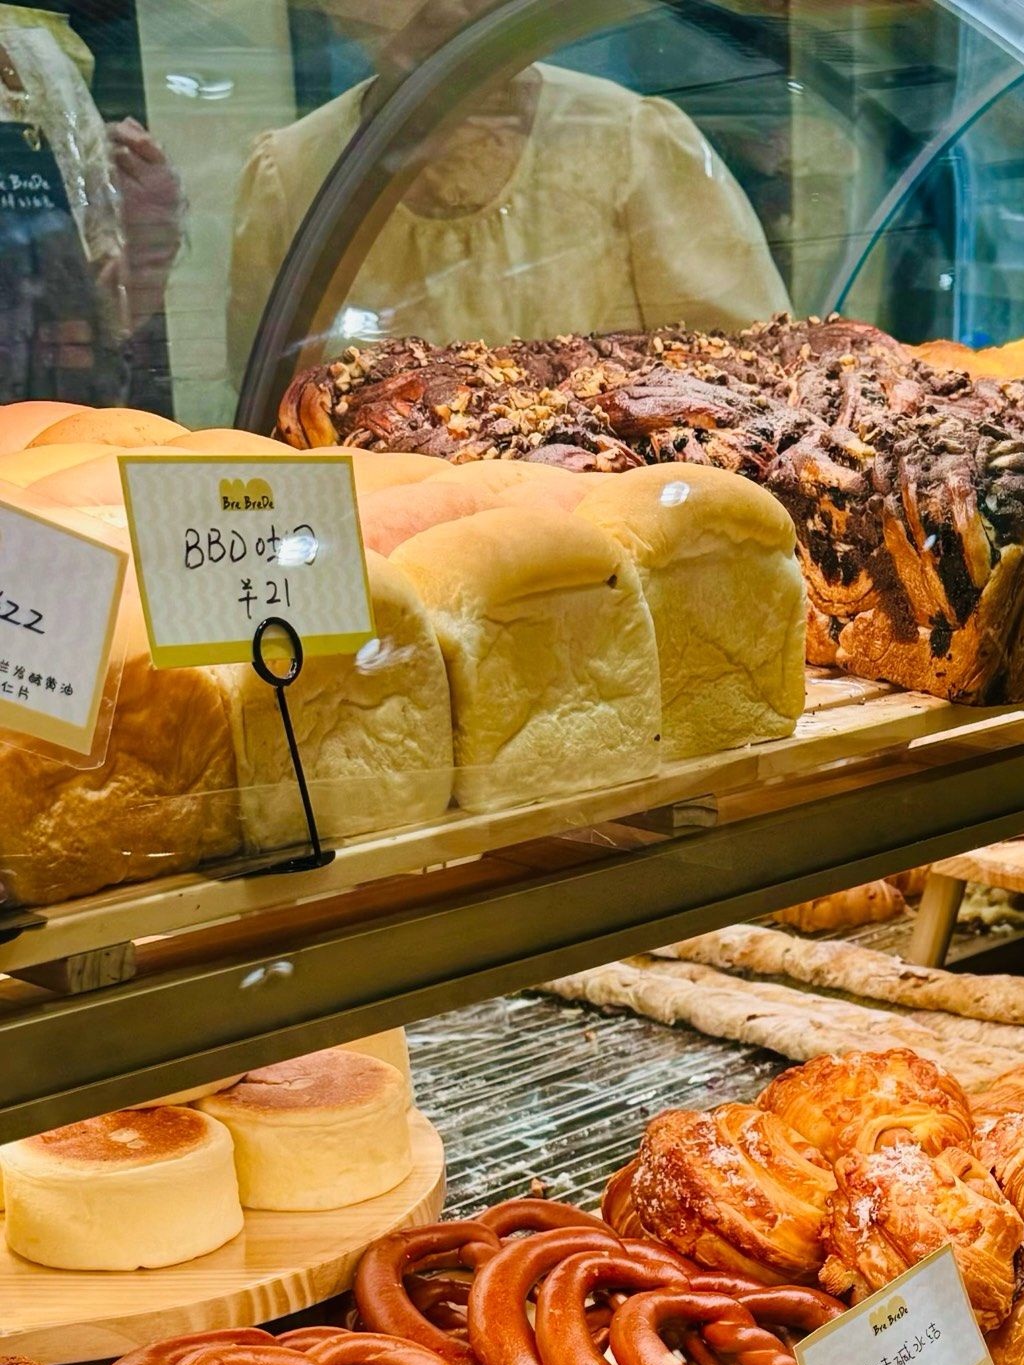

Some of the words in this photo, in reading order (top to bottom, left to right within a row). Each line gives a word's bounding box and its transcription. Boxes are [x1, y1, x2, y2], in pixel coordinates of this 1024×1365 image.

[222, 495, 242, 511] Bre
[243, 494, 275, 511] BreDe
[872, 1322, 888, 1336] Bre
[888, 1306, 909, 1325] BreDe
